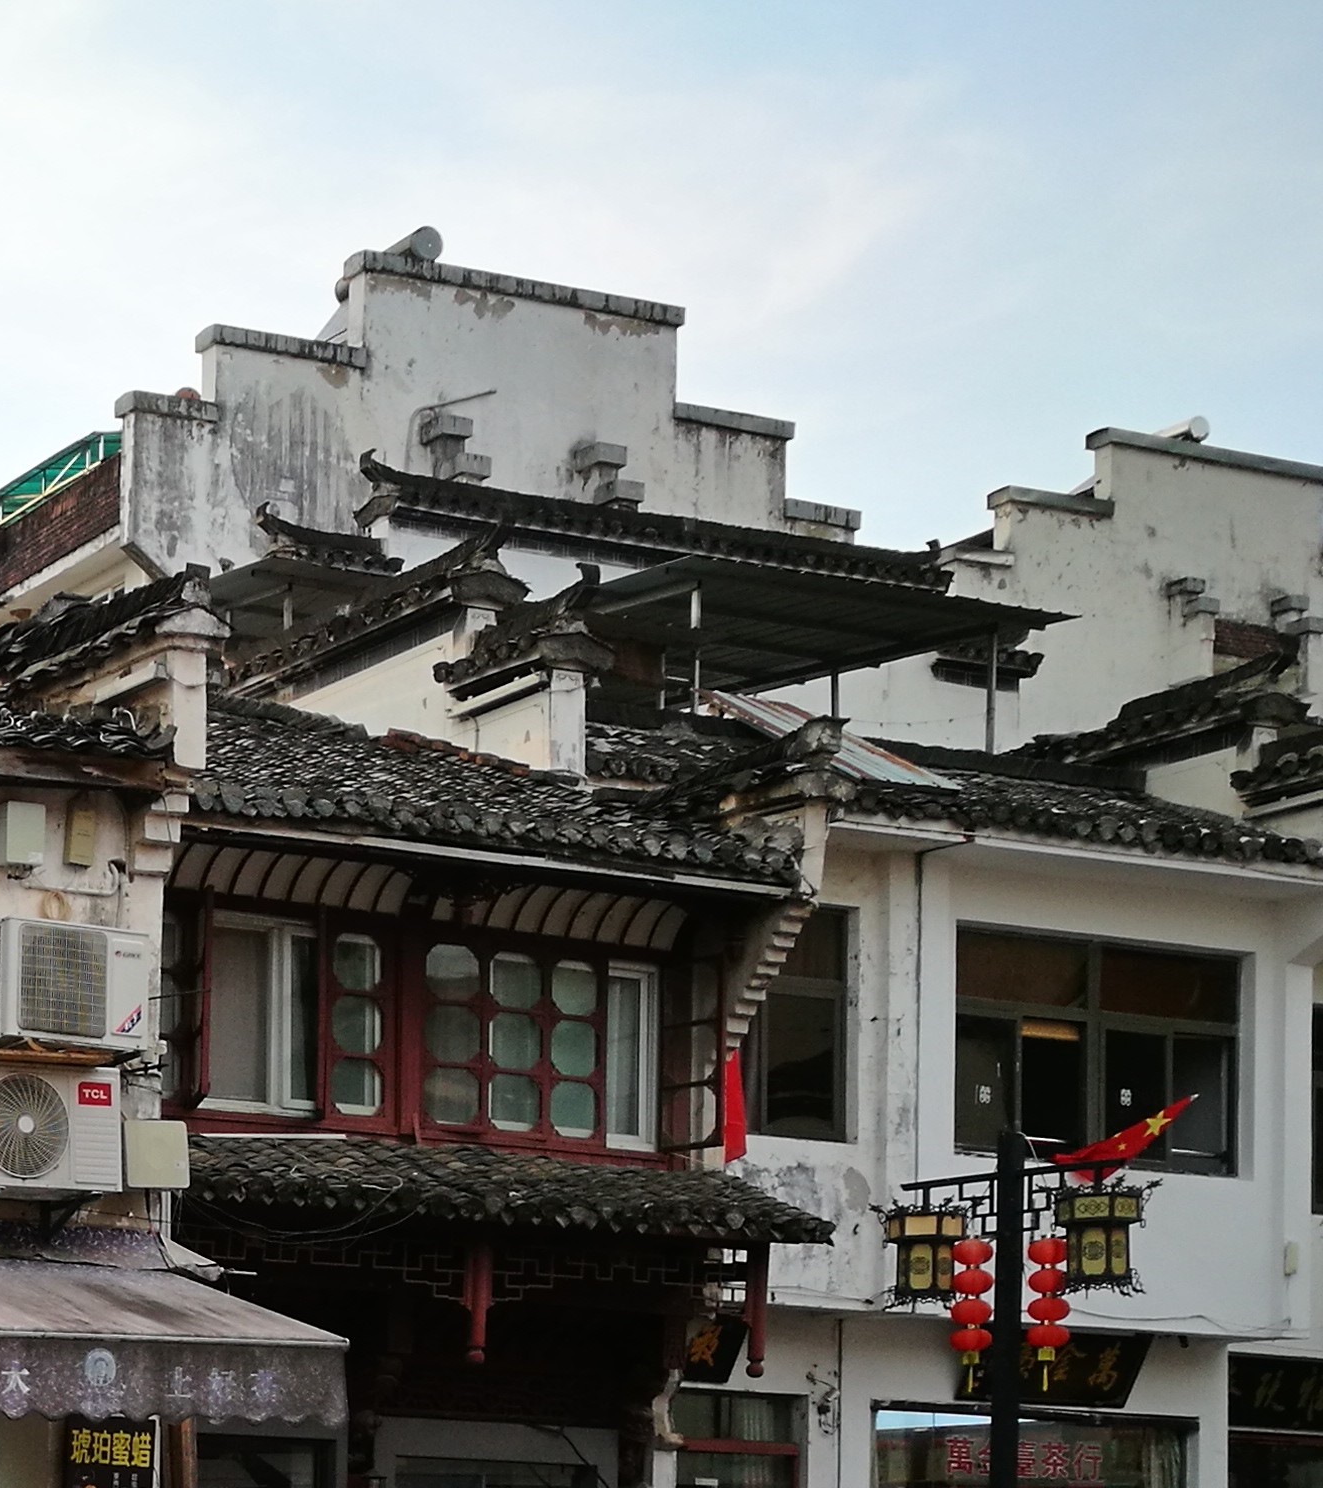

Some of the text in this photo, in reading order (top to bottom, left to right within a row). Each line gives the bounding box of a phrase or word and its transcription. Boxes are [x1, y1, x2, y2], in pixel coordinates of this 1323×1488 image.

[82, 1088, 108, 1099] TCL
[70, 1429, 152, 1468] 琥珀蜜蜡
